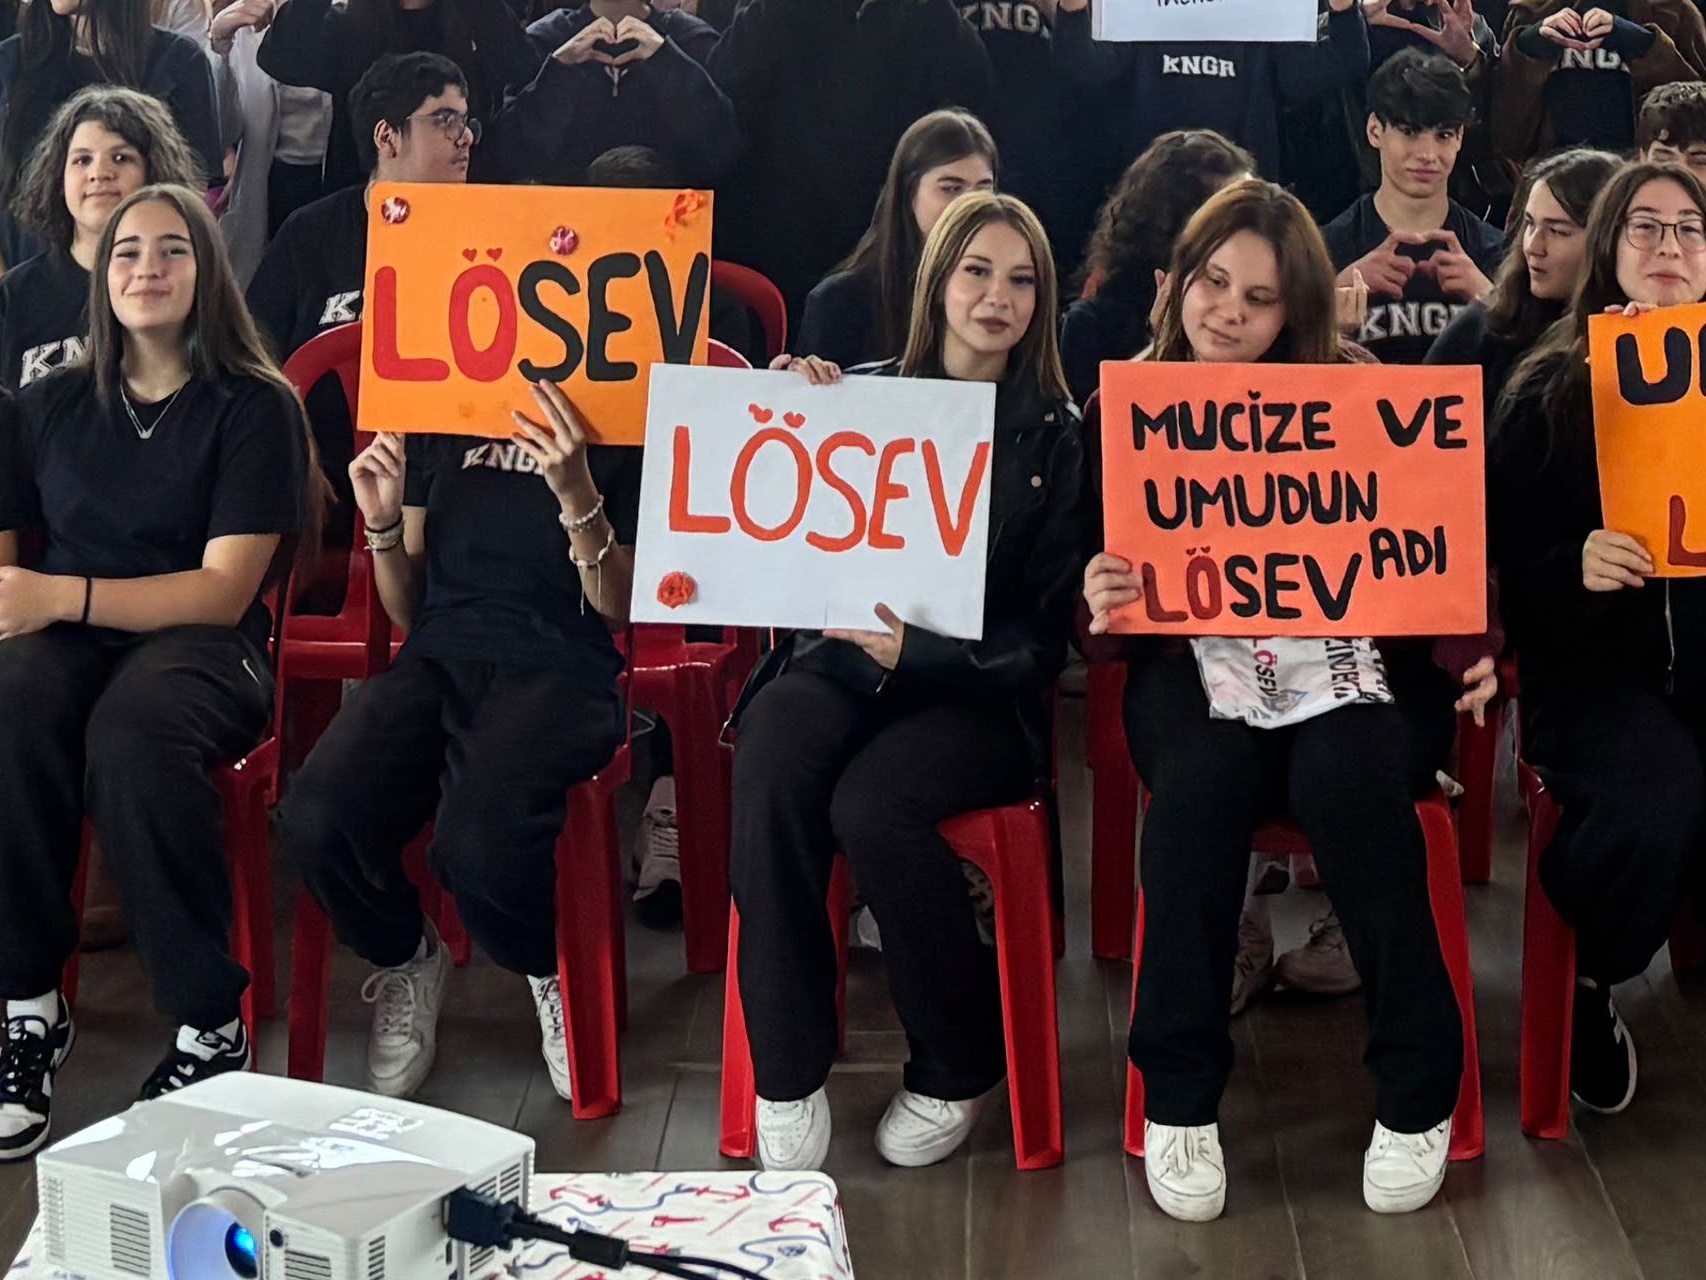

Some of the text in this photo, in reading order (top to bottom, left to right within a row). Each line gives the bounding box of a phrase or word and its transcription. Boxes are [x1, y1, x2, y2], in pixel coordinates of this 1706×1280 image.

[1162, 53, 1236, 78] KNGR
[372, 247, 710, 384] LÖSEV
[1131, 389, 1468, 454] MUCİZE VE
[669, 402, 991, 557] LÖSEV
[1144, 470, 1378, 530] UMUDUN
[1142, 545, 1363, 623] LÖSEV
[1369, 525, 1447, 580] ADI
